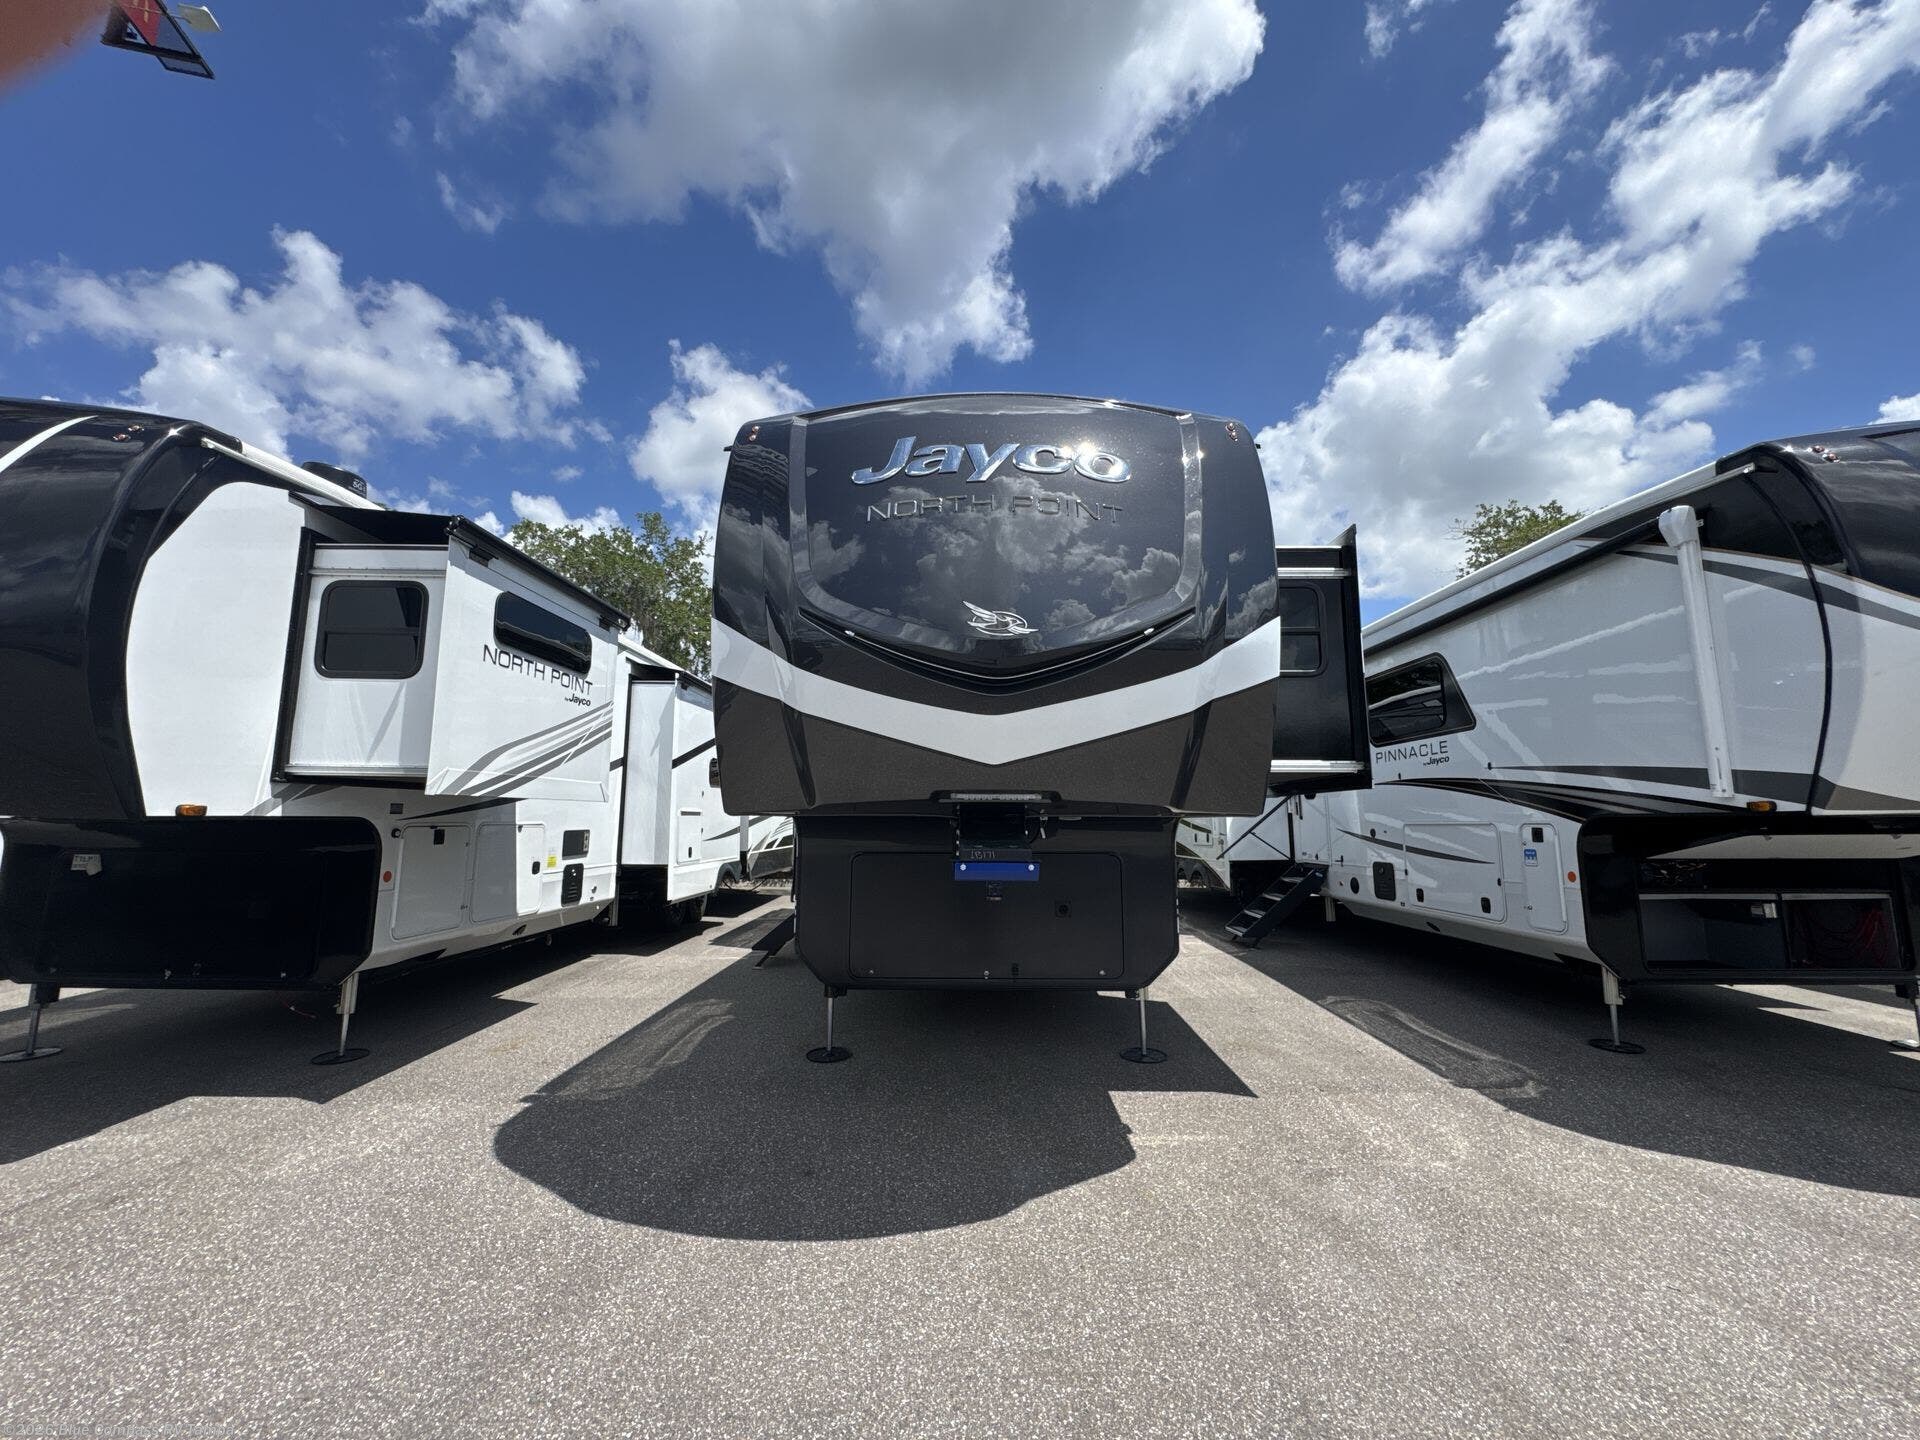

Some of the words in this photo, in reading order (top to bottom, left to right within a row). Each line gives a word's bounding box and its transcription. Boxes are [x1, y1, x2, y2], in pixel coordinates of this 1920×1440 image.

[851, 436, 1131, 484] Jayco
[866, 495, 997, 522] NORTH
[1012, 496, 1123, 523] POINT
[483, 644, 546, 681] NORTH
[551, 669, 593, 695] POINT
[568, 693, 591, 706] Jayco
[1375, 741, 1449, 764] PINNACLE
[1427, 756, 1450, 766] Jayco
